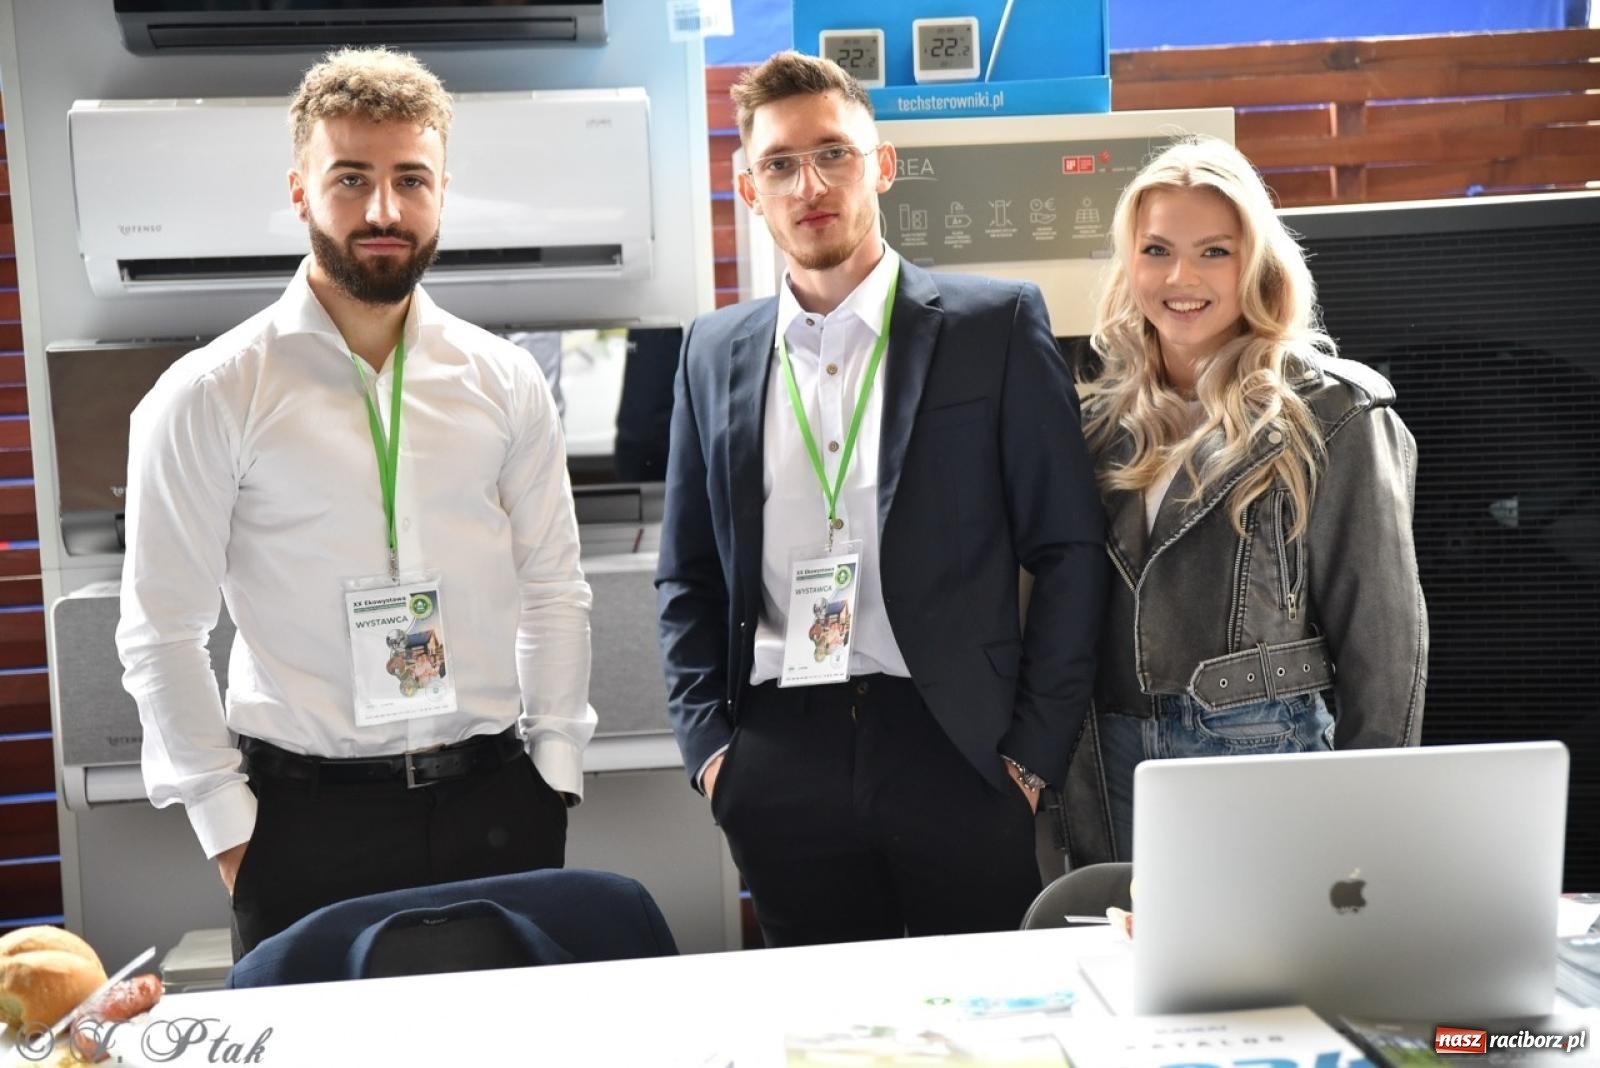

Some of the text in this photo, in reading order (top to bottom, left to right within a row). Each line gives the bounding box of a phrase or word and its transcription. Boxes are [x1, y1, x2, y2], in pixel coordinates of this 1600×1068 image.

[897, 90, 1004, 112] techsterowniki.pl
[795, 585, 833, 595] WYSTAWCA
[364, 596, 406, 606] Ekowystawa
[355, 615, 409, 629] WYSTAWCA
